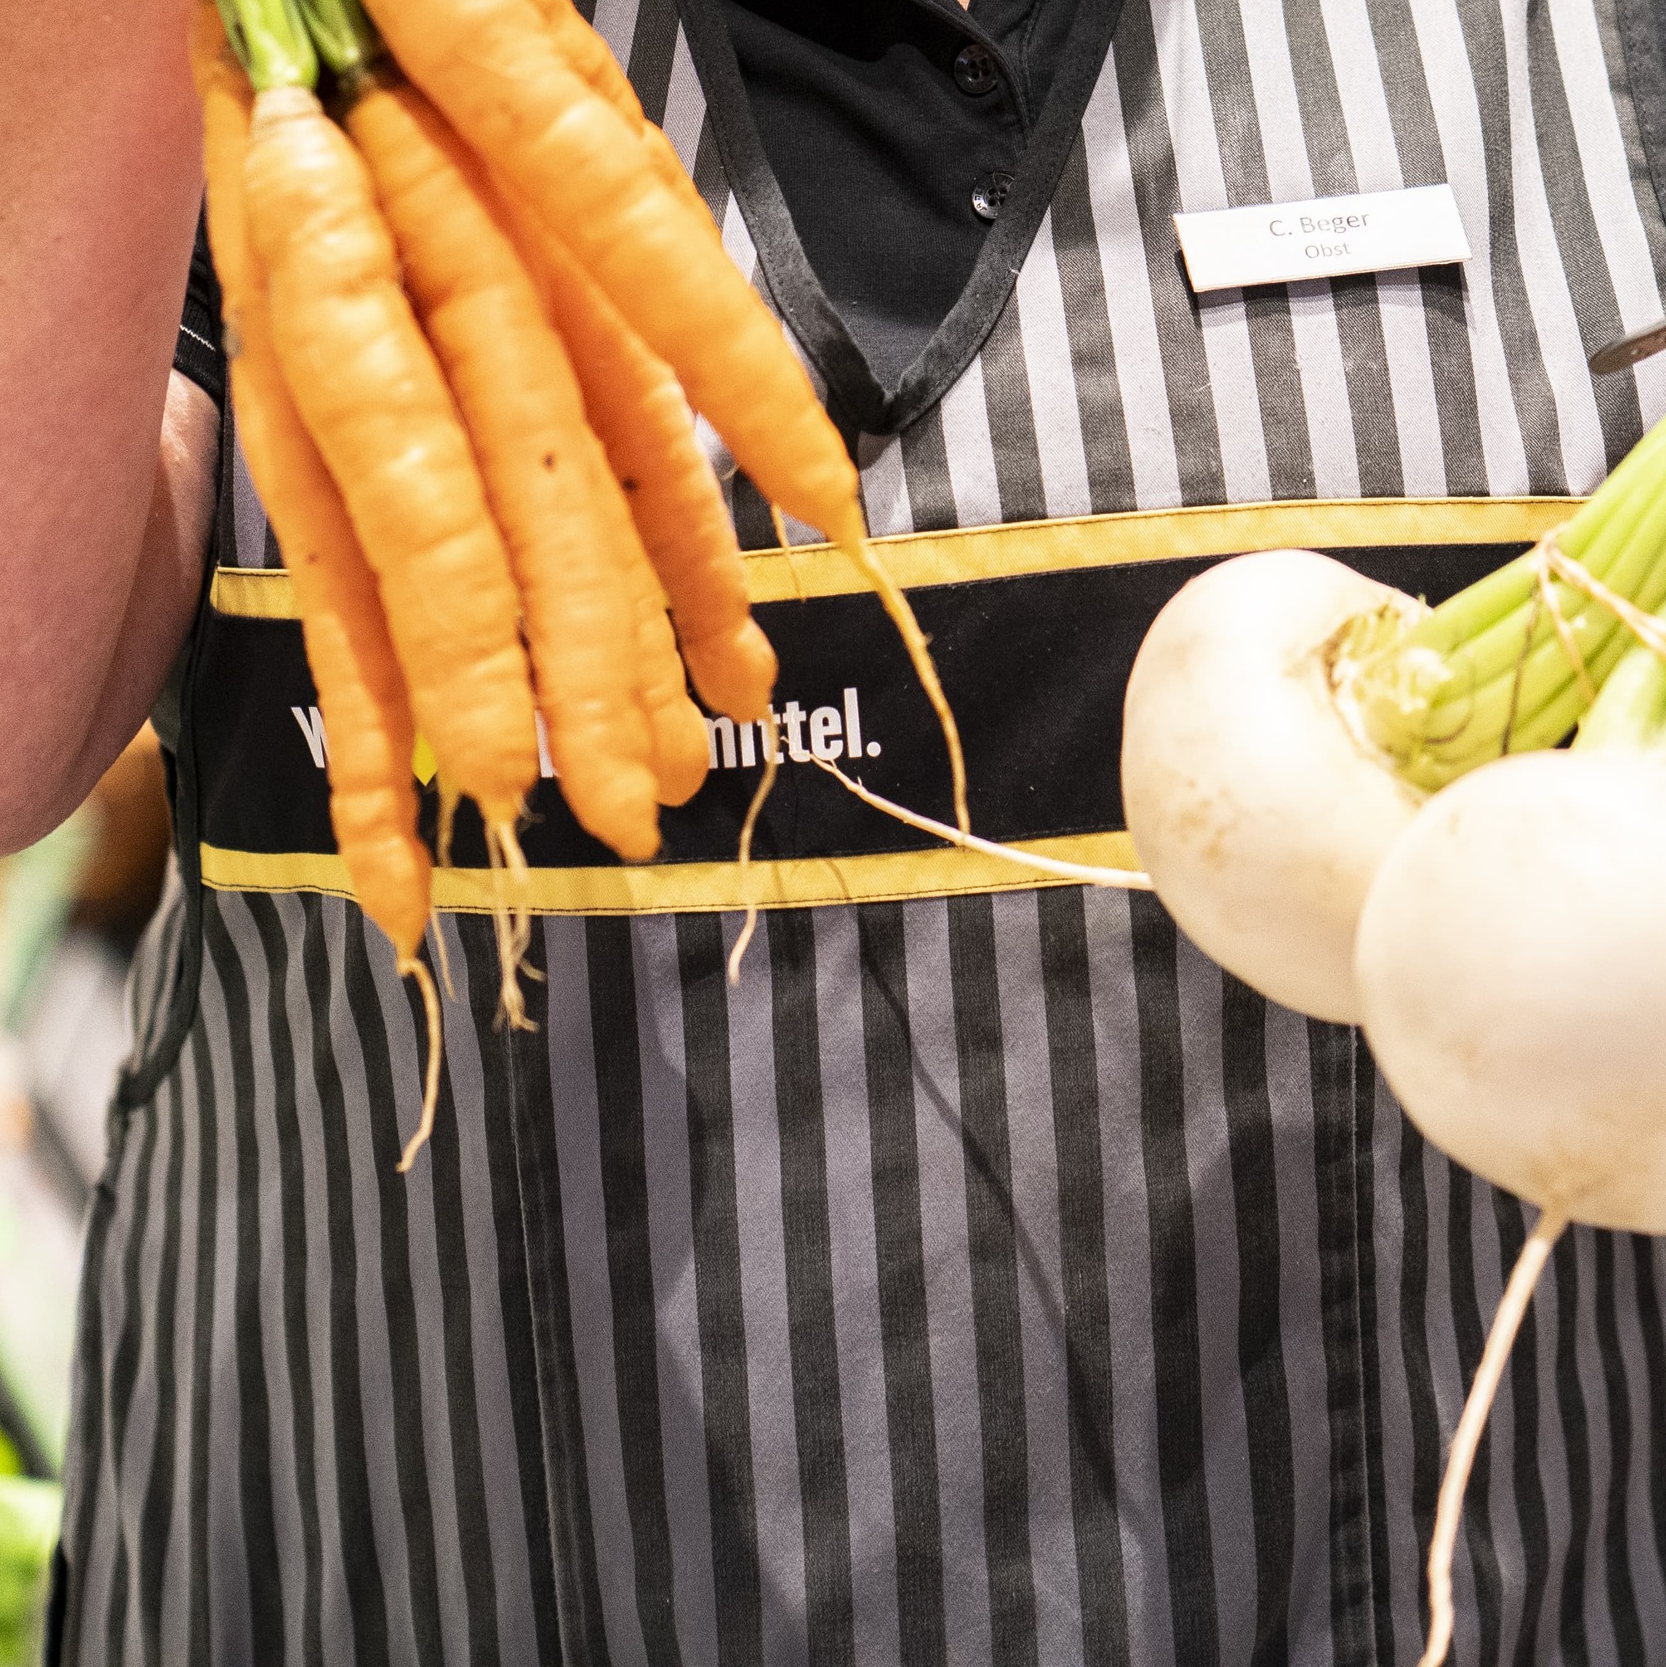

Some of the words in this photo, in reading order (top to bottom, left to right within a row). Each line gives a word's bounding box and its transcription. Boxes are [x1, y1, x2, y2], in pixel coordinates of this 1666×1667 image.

[1269, 219, 1293, 237] C.
[1299, 213, 1370, 234] Beger
[1304, 242, 1351, 259] Obst
